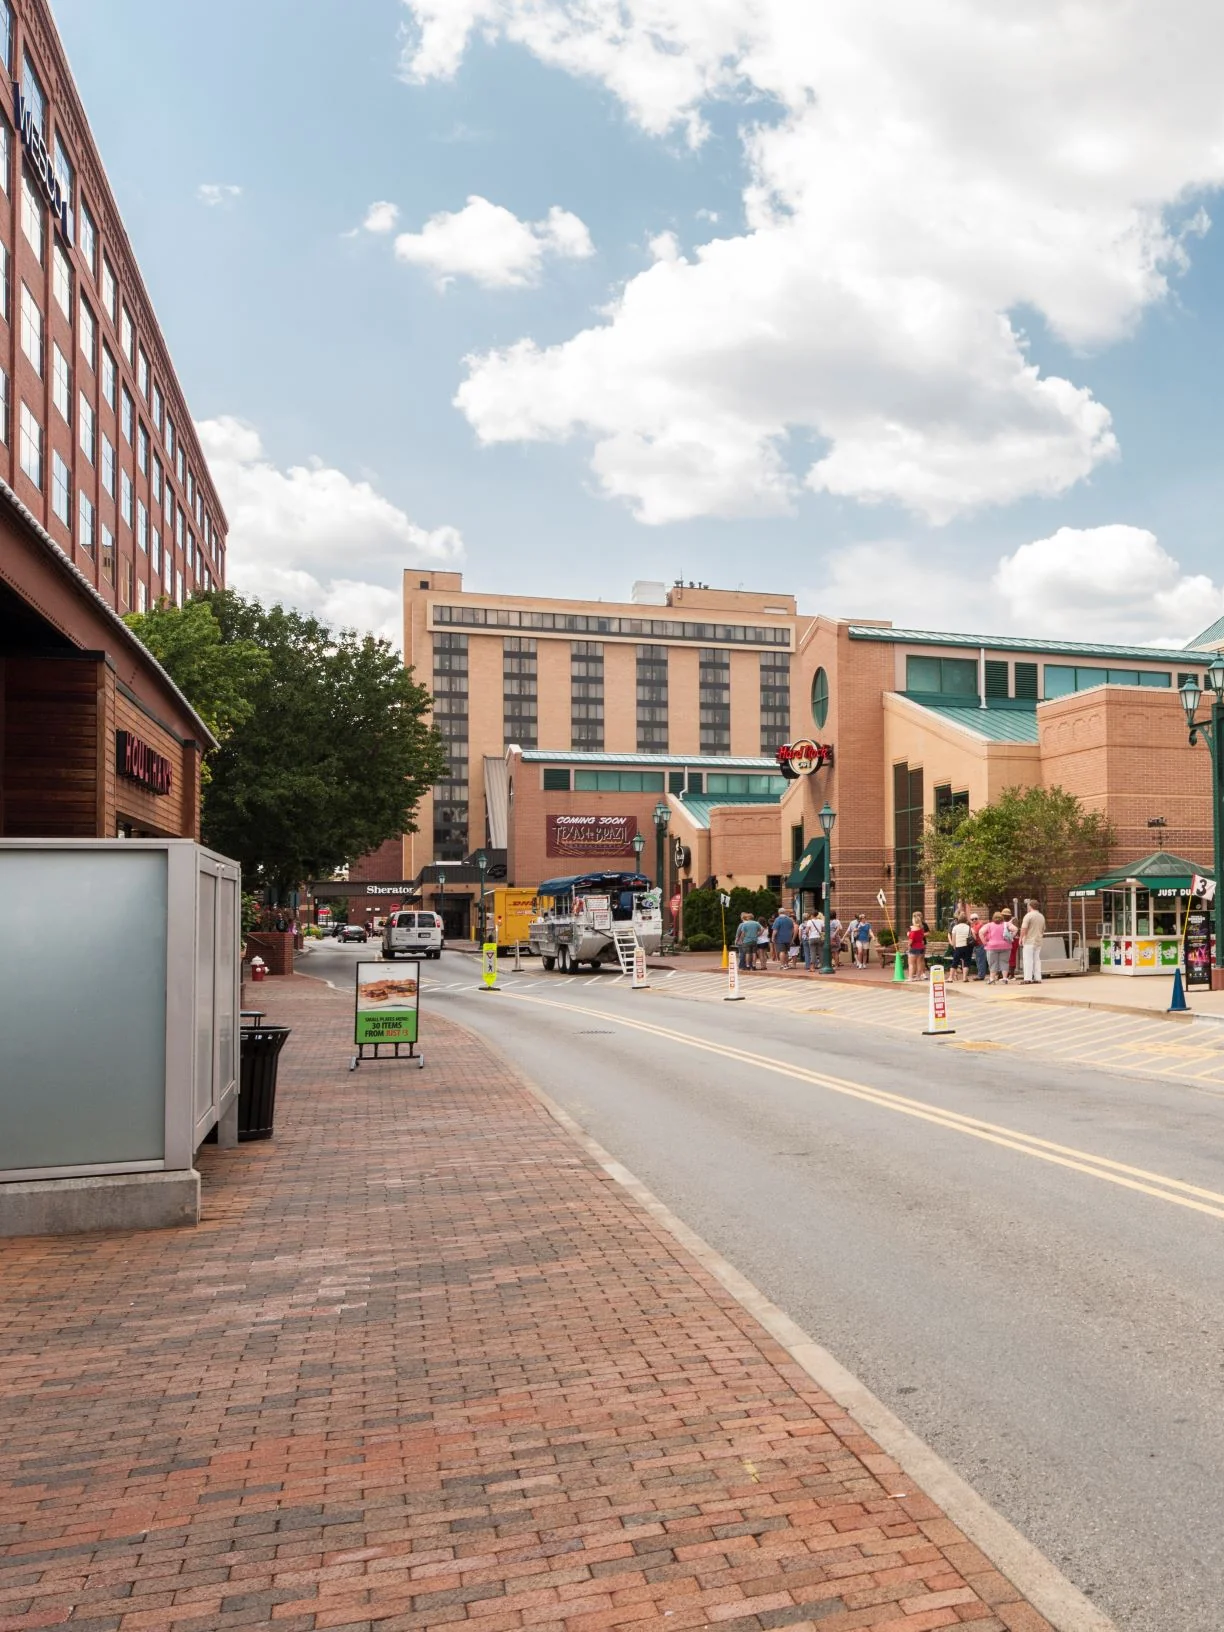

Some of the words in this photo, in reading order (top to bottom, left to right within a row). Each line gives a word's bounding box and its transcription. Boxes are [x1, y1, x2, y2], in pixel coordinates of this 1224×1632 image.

[557, 816, 595, 824] COMING
[599, 817, 627, 825] SOON
[552, 826, 585, 844] TEXAS
[596, 827, 631, 844] BRAZIL
[1196, 879, 1207, 896] 3
[1157, 889, 1177, 897] JUST
[372, 1022, 380, 1030] 30
